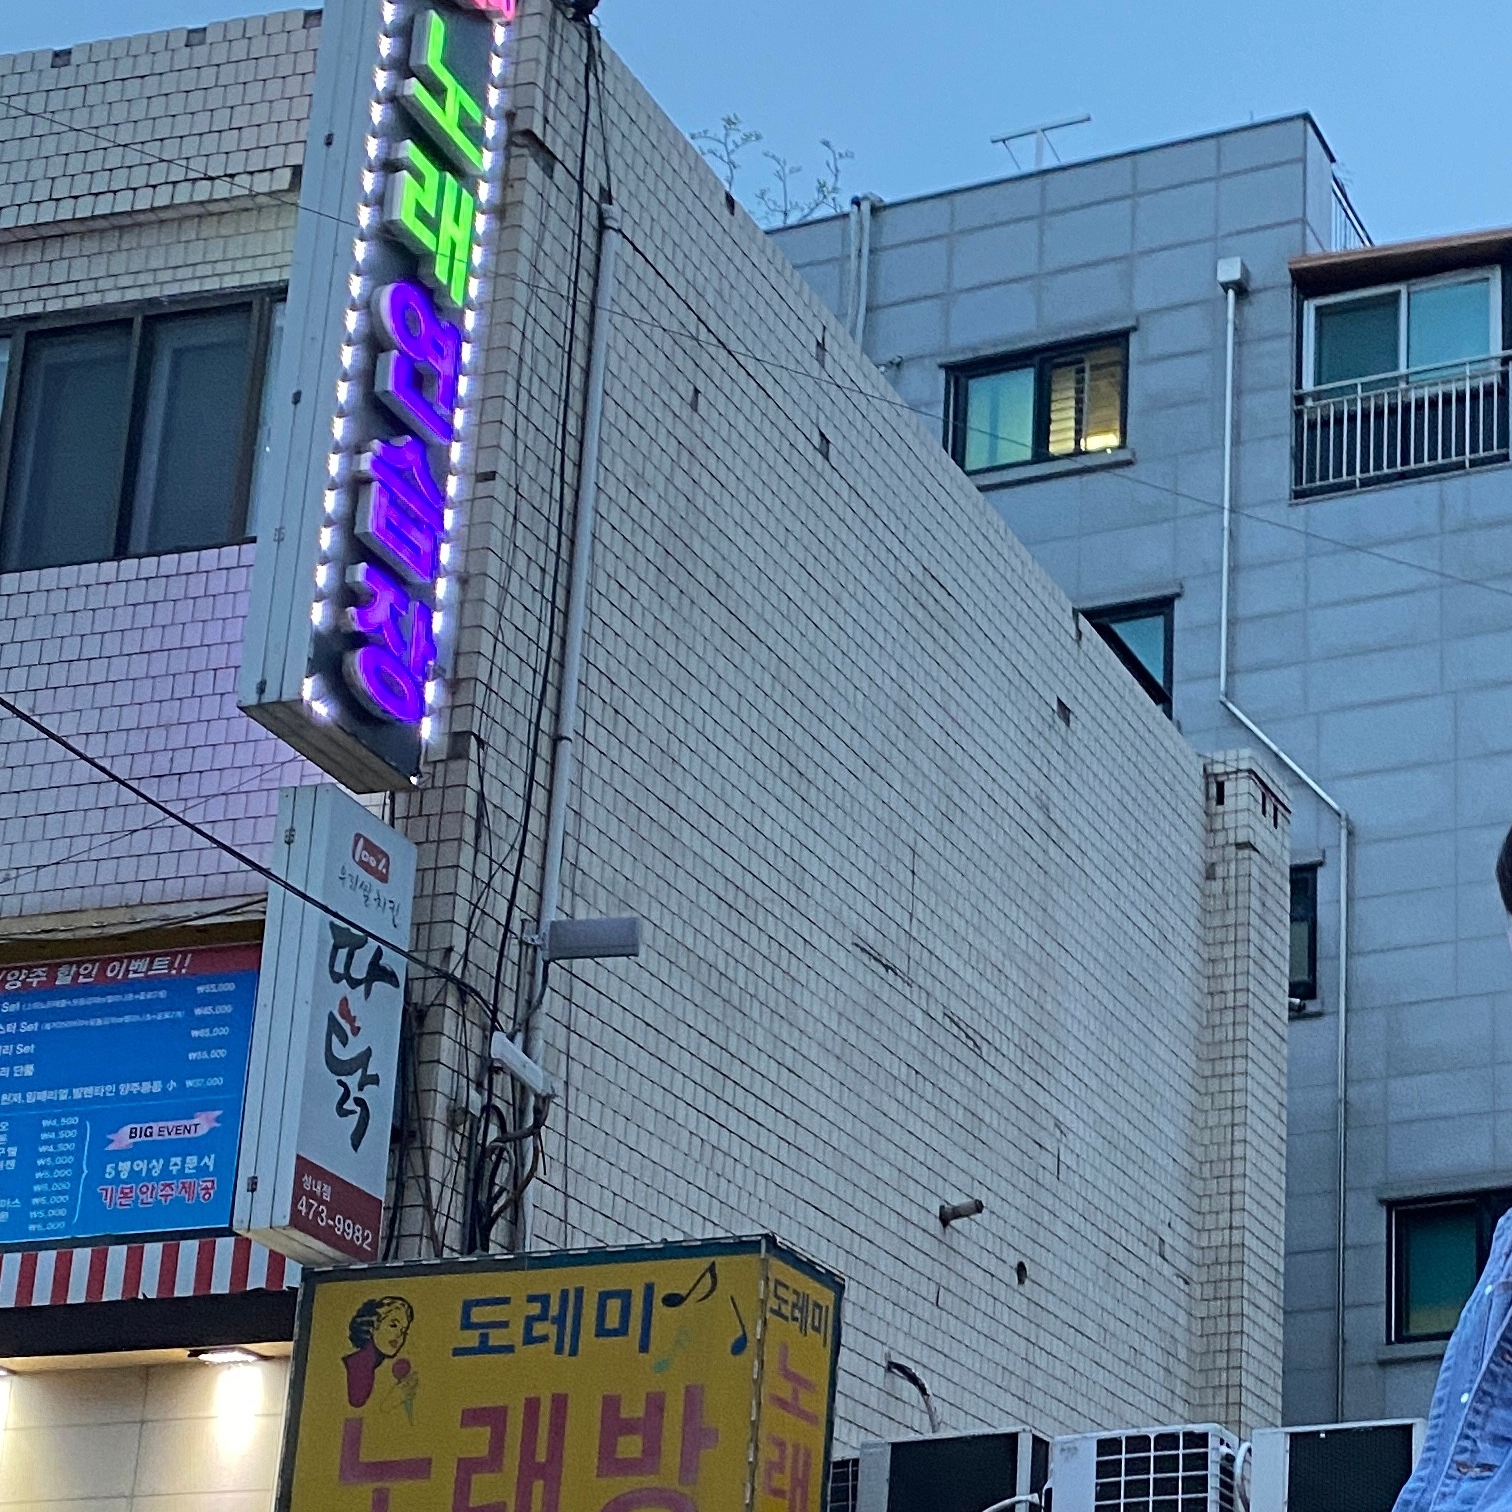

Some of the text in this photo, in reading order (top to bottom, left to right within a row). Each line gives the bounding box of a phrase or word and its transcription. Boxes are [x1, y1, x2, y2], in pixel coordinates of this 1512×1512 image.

[344, 8, 485, 726] 노래연습장
[55, 961, 99, 986] 할인
[106, 953, 192, 979] 이벤트!!
[19, 1022, 38, 1034] Set
[16, 1043, 35, 1055] Set
[128, 1122, 201, 1140] BIG EVENT
[104, 1154, 215, 1180] 5병이상 주문시
[97, 1176, 217, 1210] 기본안주제공
[297, 1195, 373, 1251] 473-9982
[452, 1282, 655, 1357] 도레미
[770, 1277, 829, 1349] 도레미
